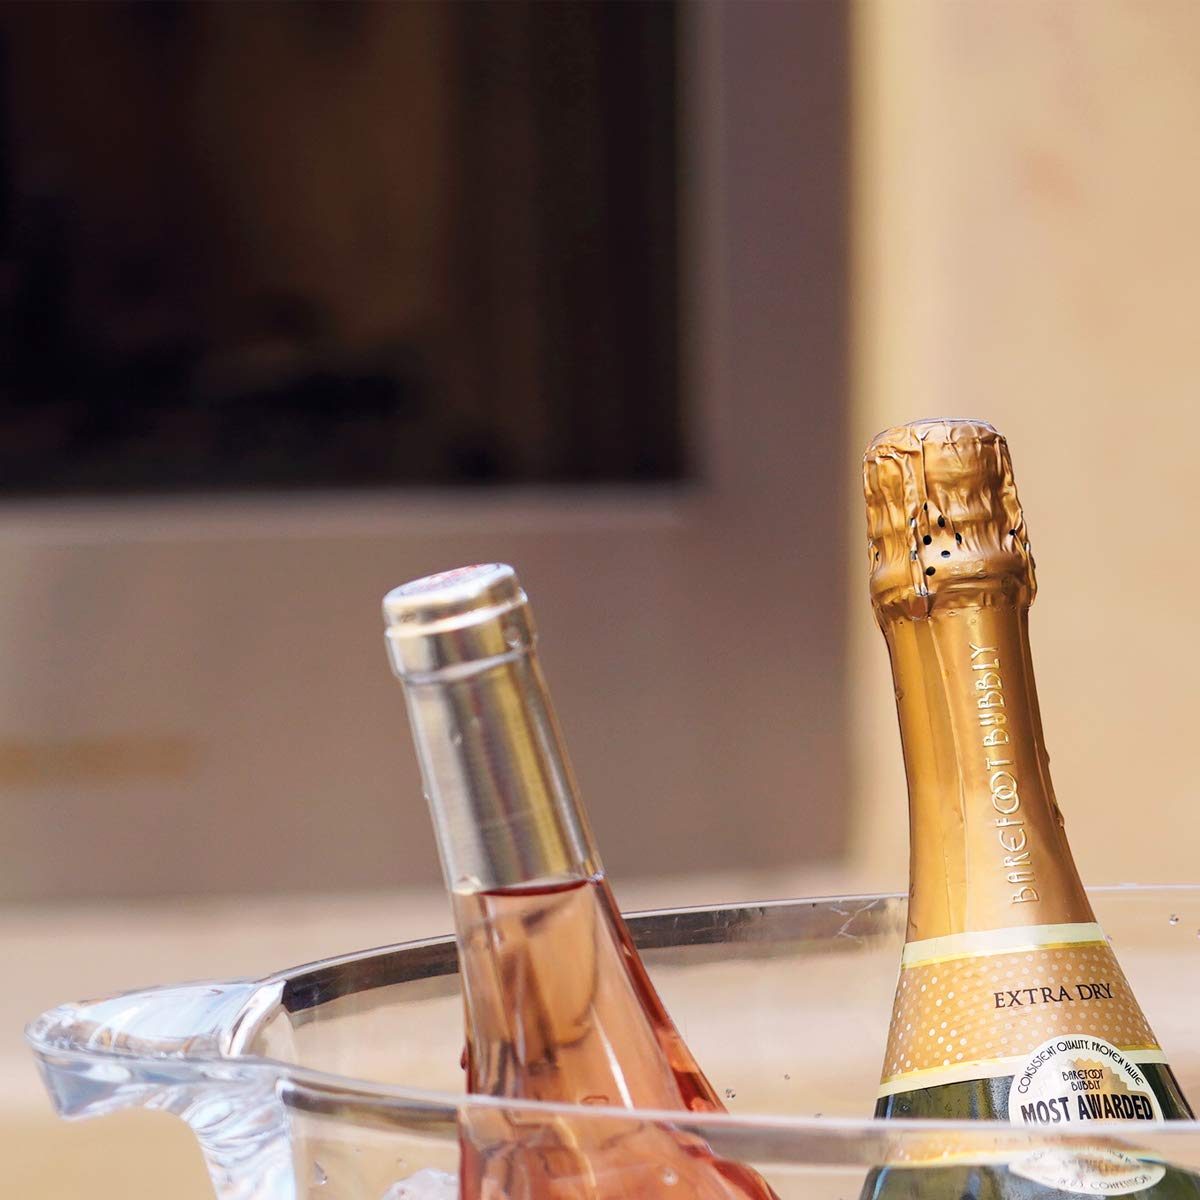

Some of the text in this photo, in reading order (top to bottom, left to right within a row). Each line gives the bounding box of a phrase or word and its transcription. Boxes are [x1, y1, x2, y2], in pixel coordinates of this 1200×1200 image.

[968, 641, 1040, 905] BAREFOOT BUBBLY
[993, 983, 1114, 1009] EXTRA DRY
[1017, 1045, 1057, 1094] CONSISTENT
[1091, 1041, 1125, 1065] PROVEN
[1123, 1061, 1144, 1086] VALUE
[1061, 1069, 1104, 1082] BAREFOOT
[1070, 1079, 1101, 1092] BUBBLY
[1020, 1093, 1154, 1126] MOST AWARDED
